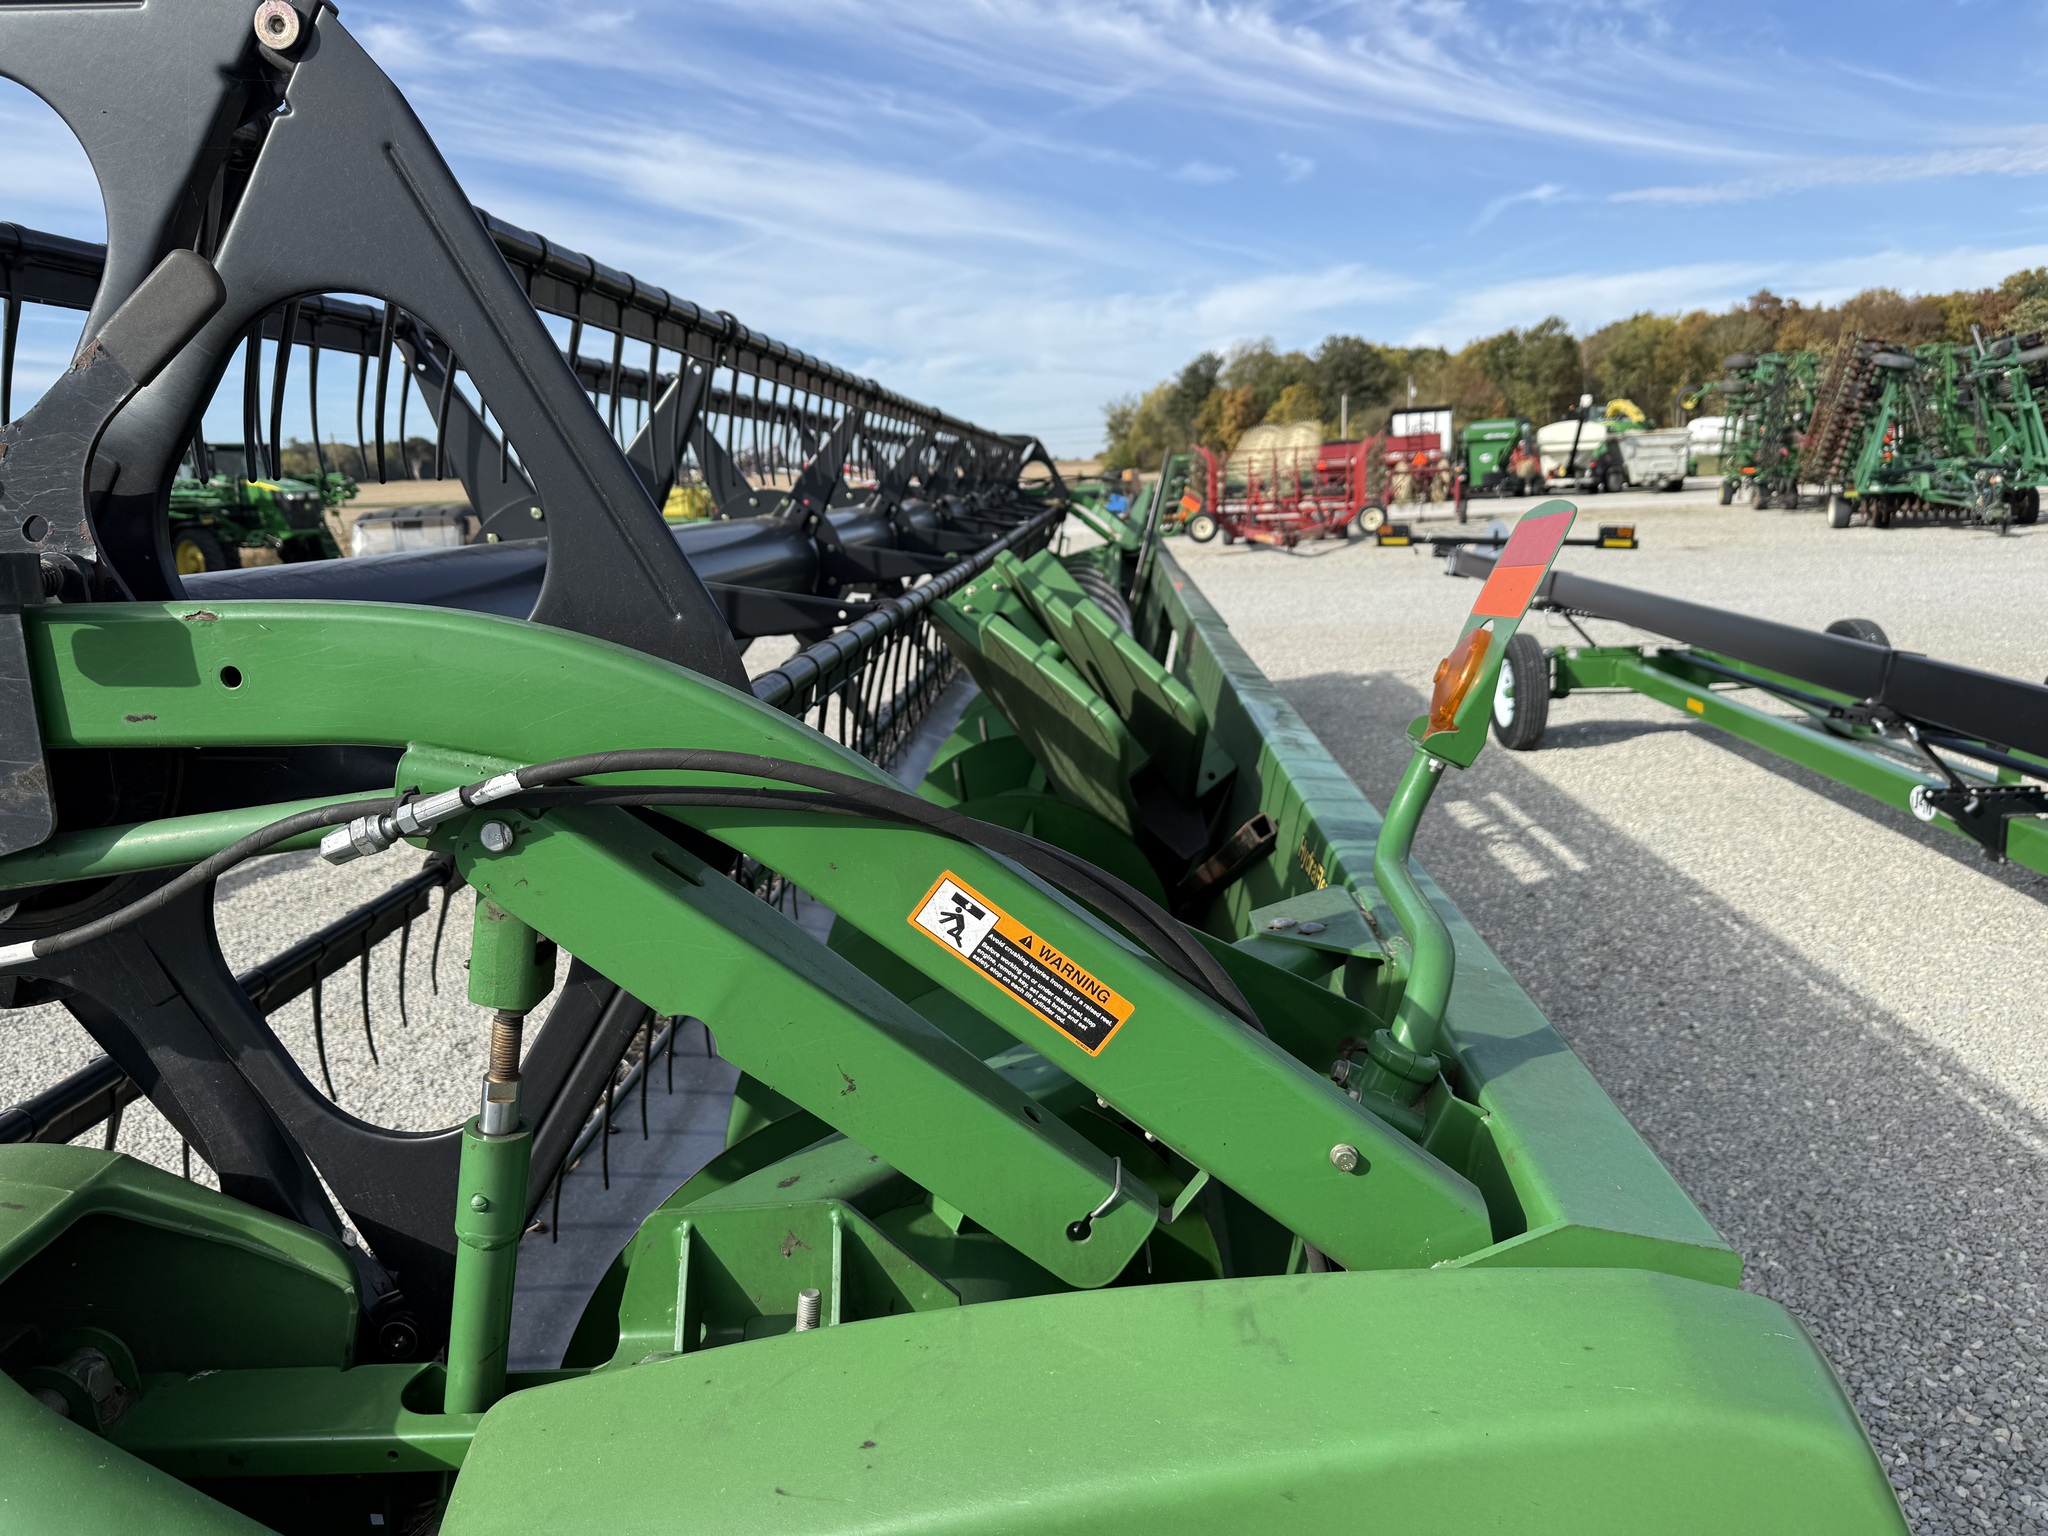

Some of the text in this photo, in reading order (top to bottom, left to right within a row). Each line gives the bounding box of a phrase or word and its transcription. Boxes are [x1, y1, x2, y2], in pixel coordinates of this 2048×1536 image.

[1297, 833, 1328, 890] HydraFle
[972, 953, 1066, 1025] safety stop on each lift cylinder rod.
[976, 948, 1089, 1031] engine, remove key, set park brake and set
[981, 941, 1001, 958] Before
[1000, 955, 1023, 975] working
[1022, 972, 1031, 981] on
[1037, 982, 1055, 997] under
[1053, 995, 1073, 1010] raised
[1070, 1007, 1084, 1020] reel,
[1082, 1016, 1097, 1028] stop
[987, 933, 1006, 948] Avoid
[1004, 945, 1030, 967] crushing
[1028, 962, 1051, 981] injuries
[1049, 977, 1064, 991] from
[1062, 987, 1074, 998] fall
[1082, 1002, 1102, 1018] raised
[1099, 1015, 1113, 1027] reel.
[1038, 944, 1111, 1004] WARNING
